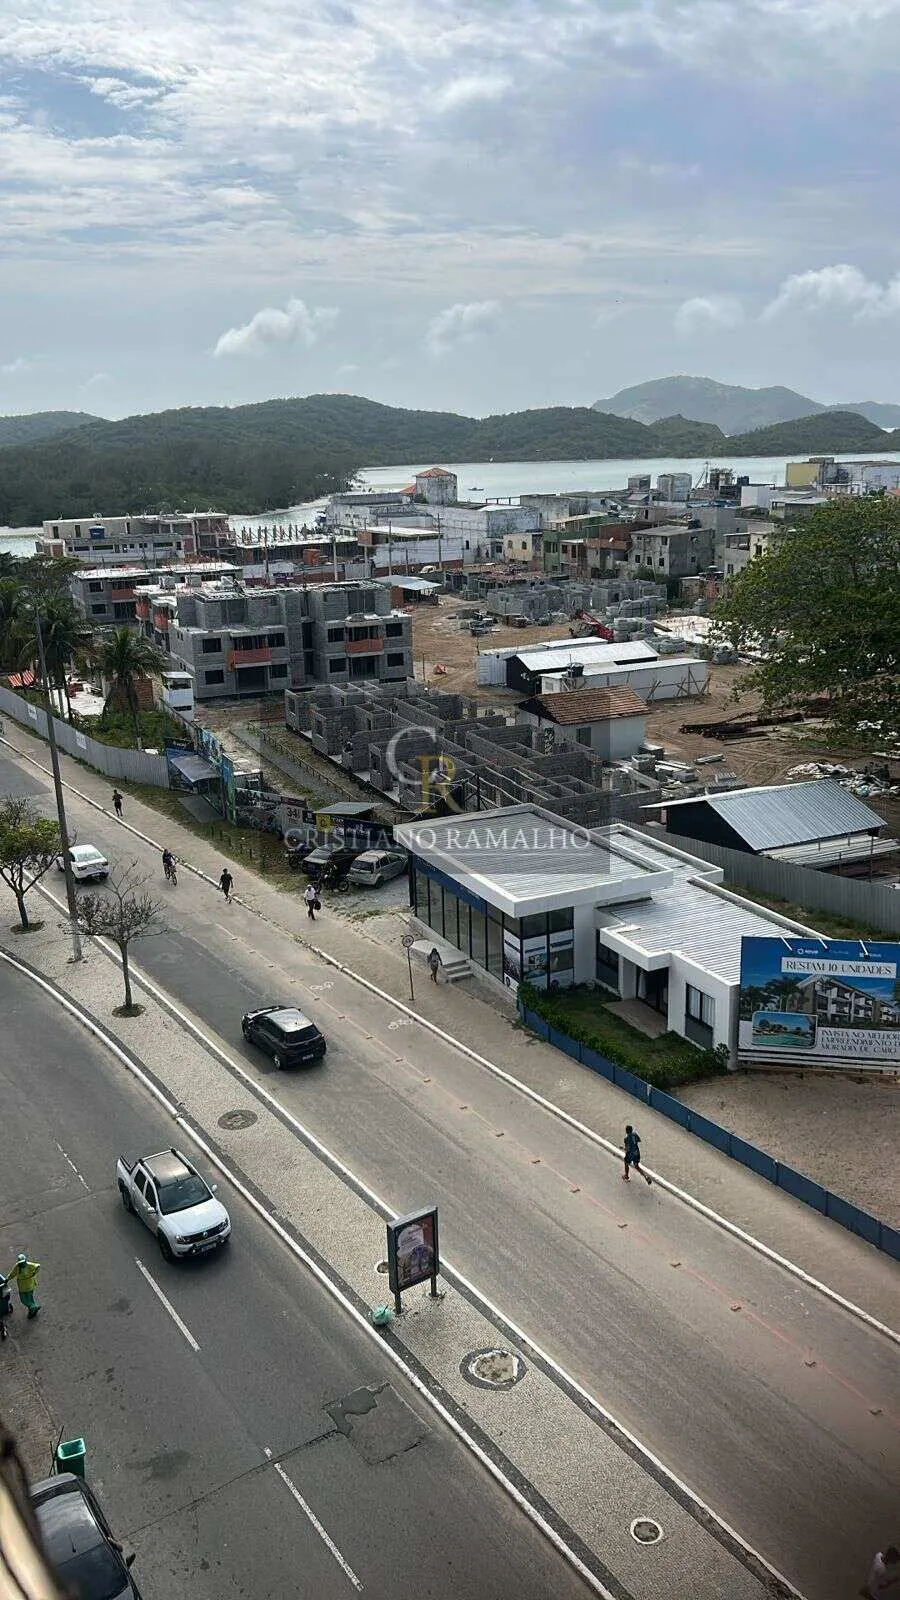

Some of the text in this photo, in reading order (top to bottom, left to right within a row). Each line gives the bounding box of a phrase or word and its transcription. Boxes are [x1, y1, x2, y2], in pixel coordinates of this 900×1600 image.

[786, 960, 892, 976] RESTAM 10 UNIDADES
